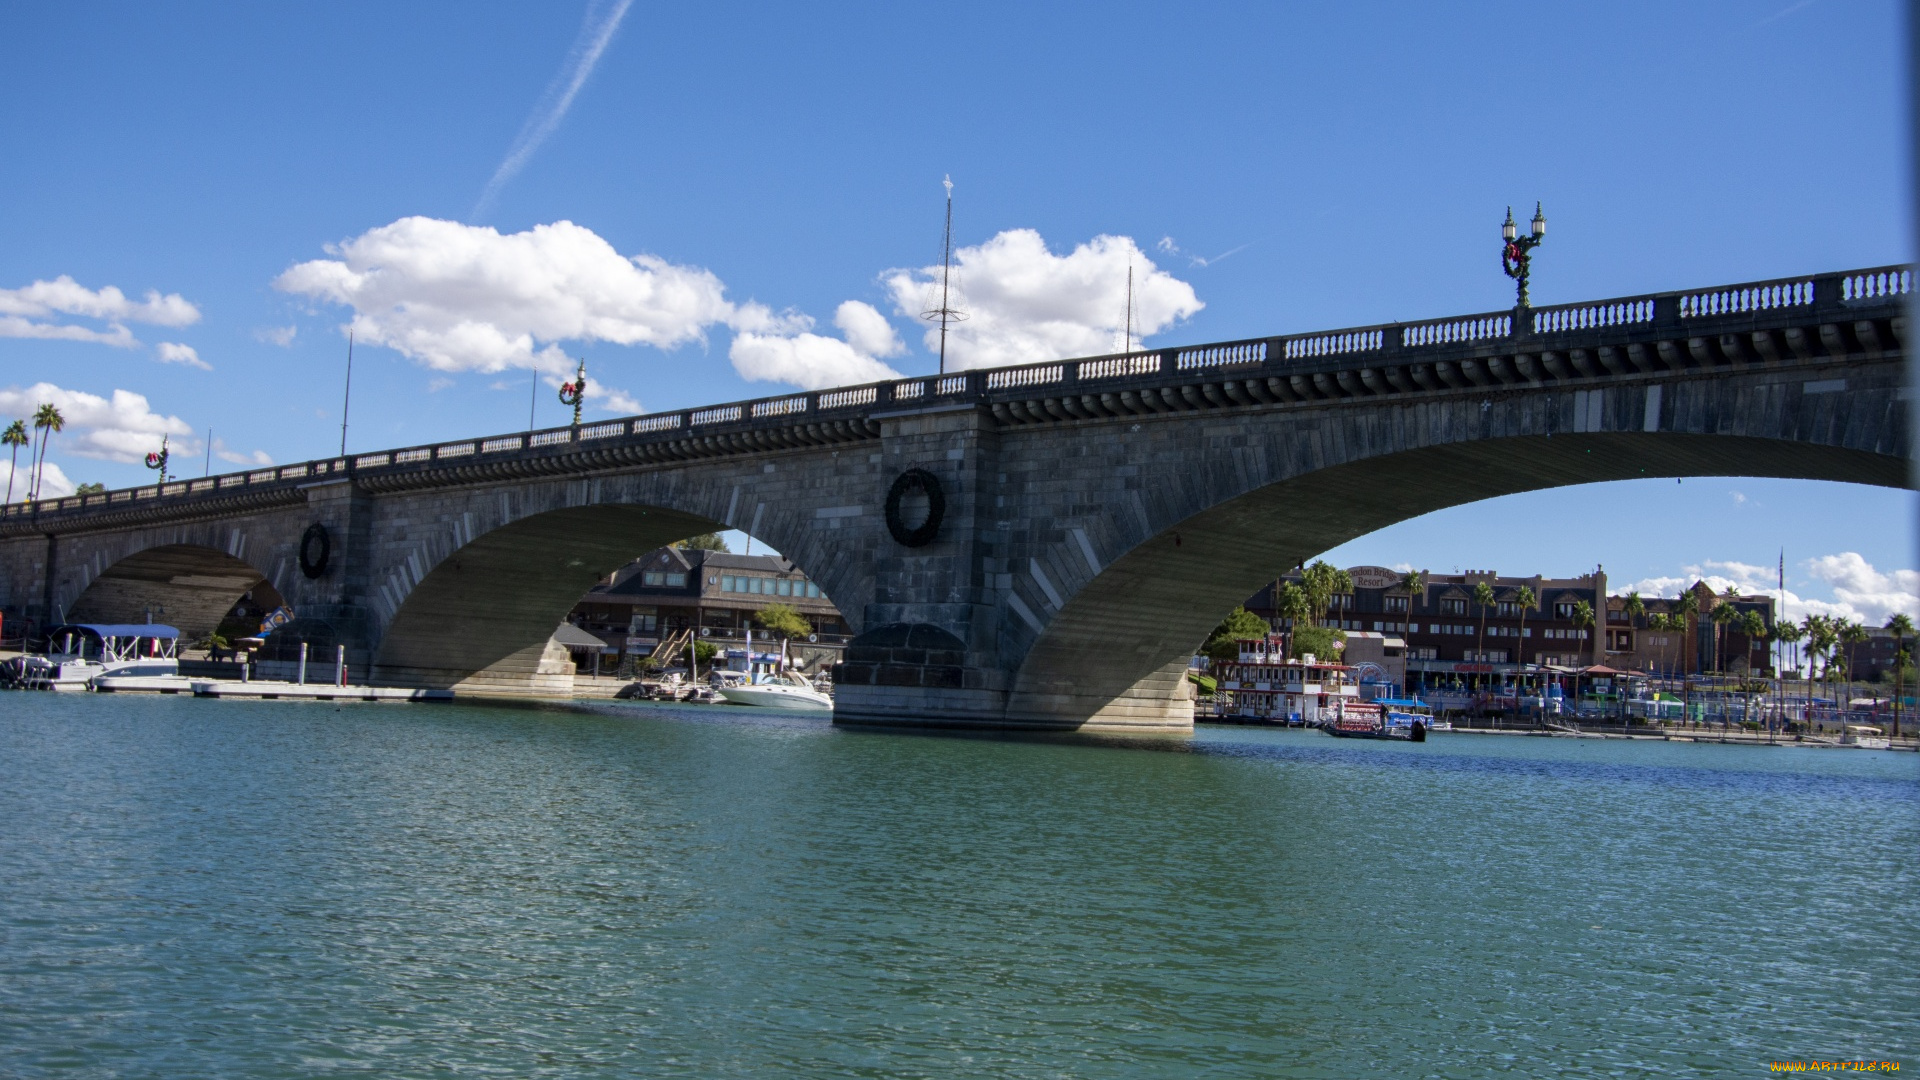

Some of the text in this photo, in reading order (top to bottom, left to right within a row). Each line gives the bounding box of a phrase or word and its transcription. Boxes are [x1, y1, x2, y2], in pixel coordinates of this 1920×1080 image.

[1349, 567, 1397, 581] ondon Bridge
[1358, 577, 1383, 586] Resort
